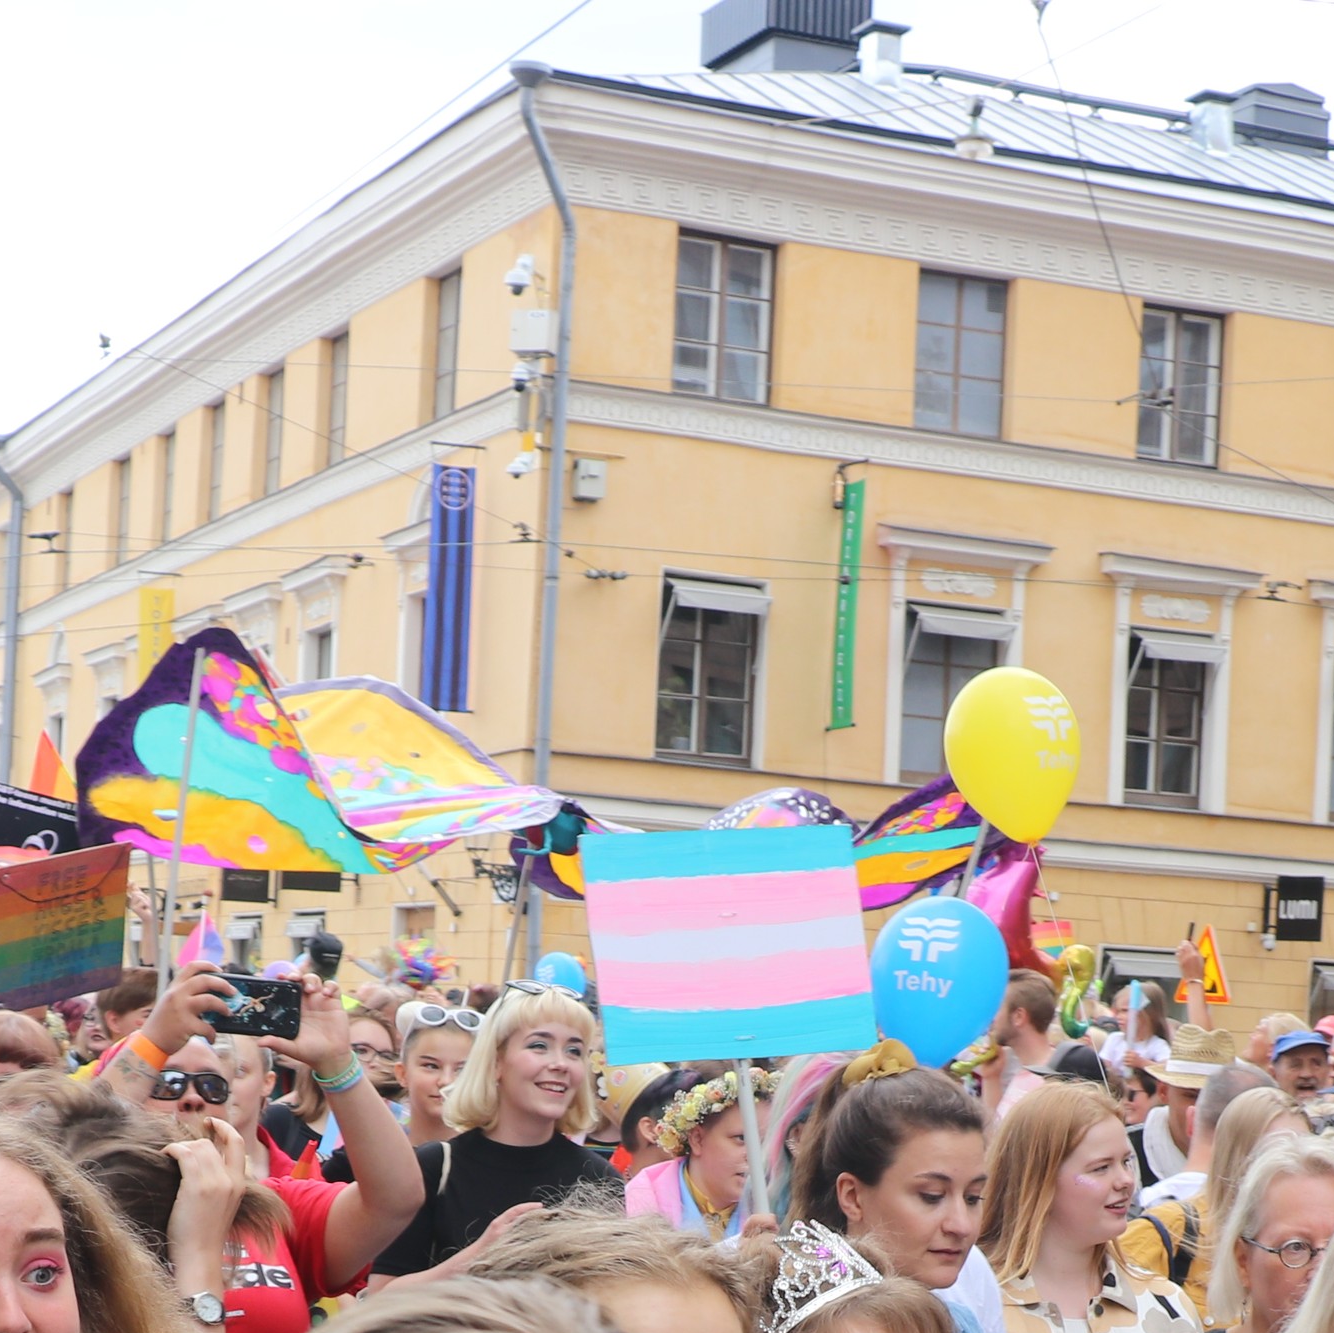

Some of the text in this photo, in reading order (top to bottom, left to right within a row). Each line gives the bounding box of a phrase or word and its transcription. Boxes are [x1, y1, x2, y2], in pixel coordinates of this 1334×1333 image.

[1034, 750, 1078, 773] Tehy
[1278, 899, 1319, 920] LUMI
[893, 969, 954, 999] Tehy
